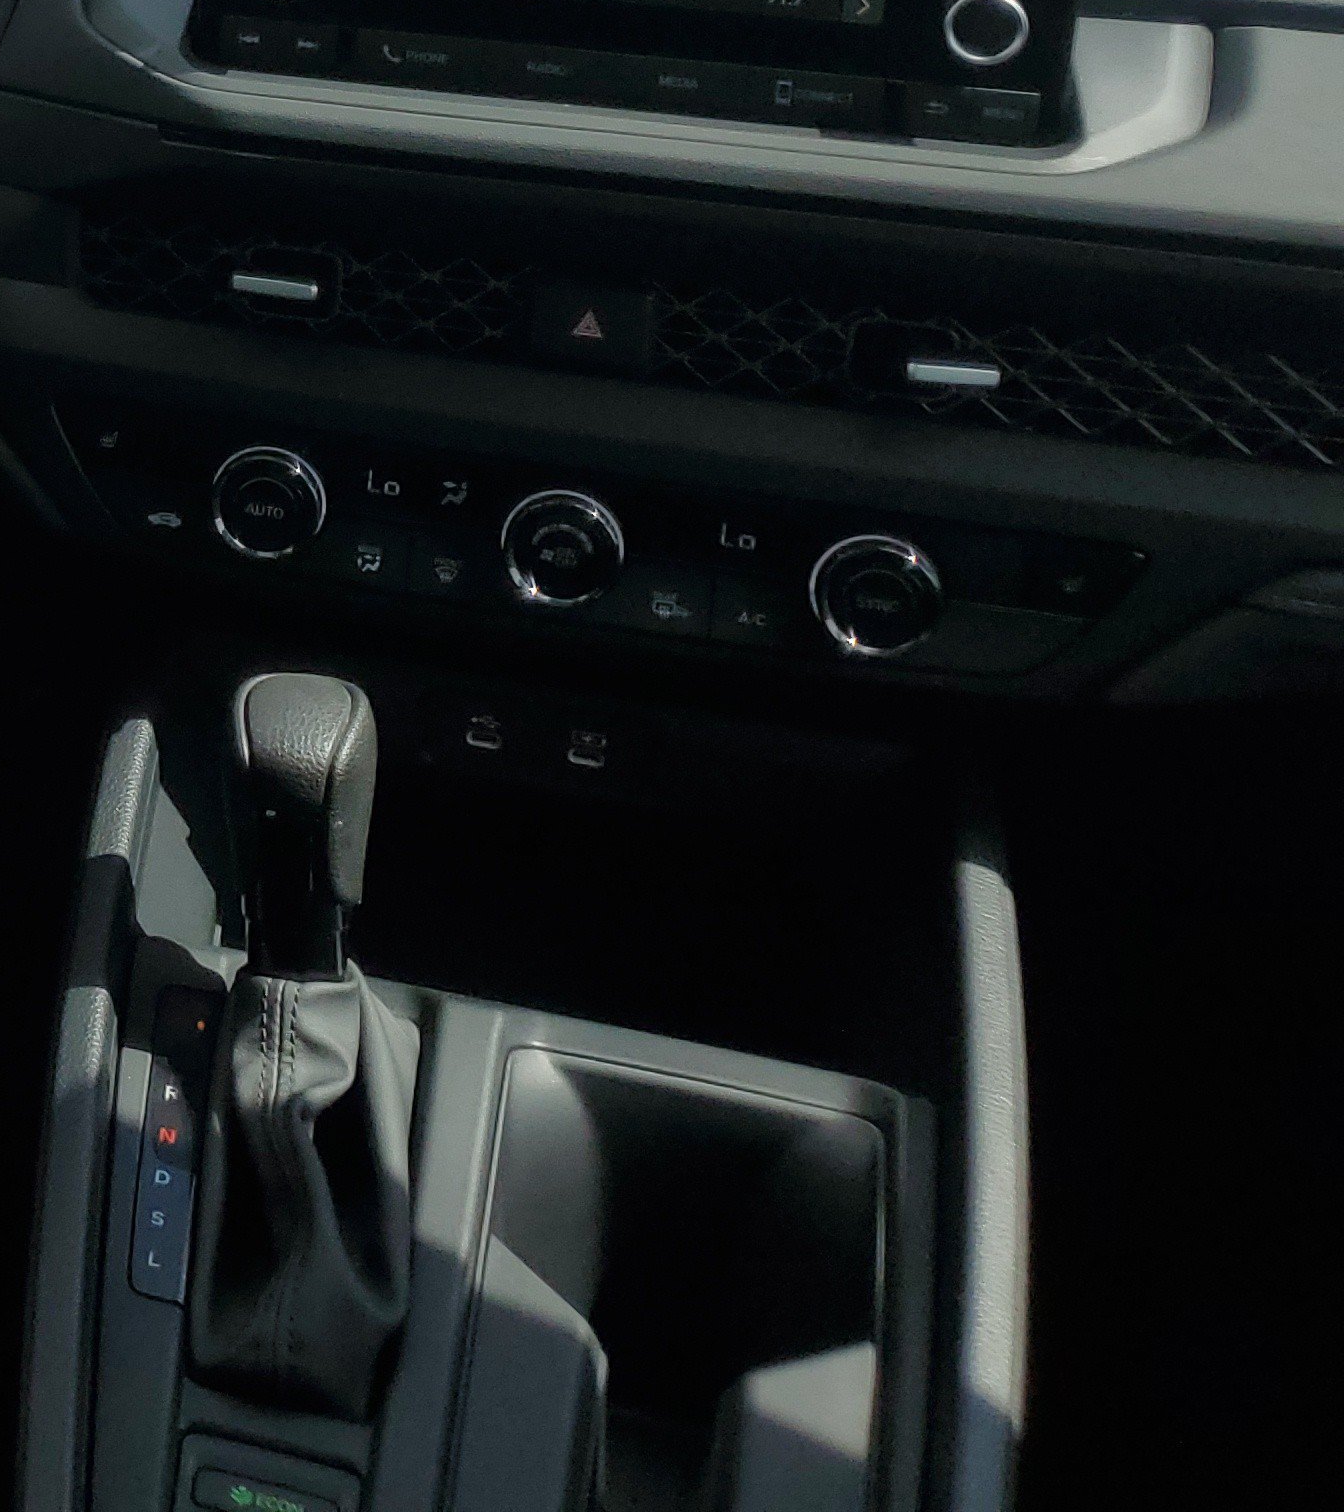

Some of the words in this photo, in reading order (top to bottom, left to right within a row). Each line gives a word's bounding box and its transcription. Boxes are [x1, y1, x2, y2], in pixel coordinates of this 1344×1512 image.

[366, 468, 401, 496] Lo
[243, 503, 285, 520] AUTO
[721, 522, 757, 550] Lo
[164, 1083, 179, 1102] R
[158, 1127, 178, 1145] N
[154, 1169, 171, 1186] D
[151, 1211, 165, 1227] S
[147, 1250, 162, 1268] L
